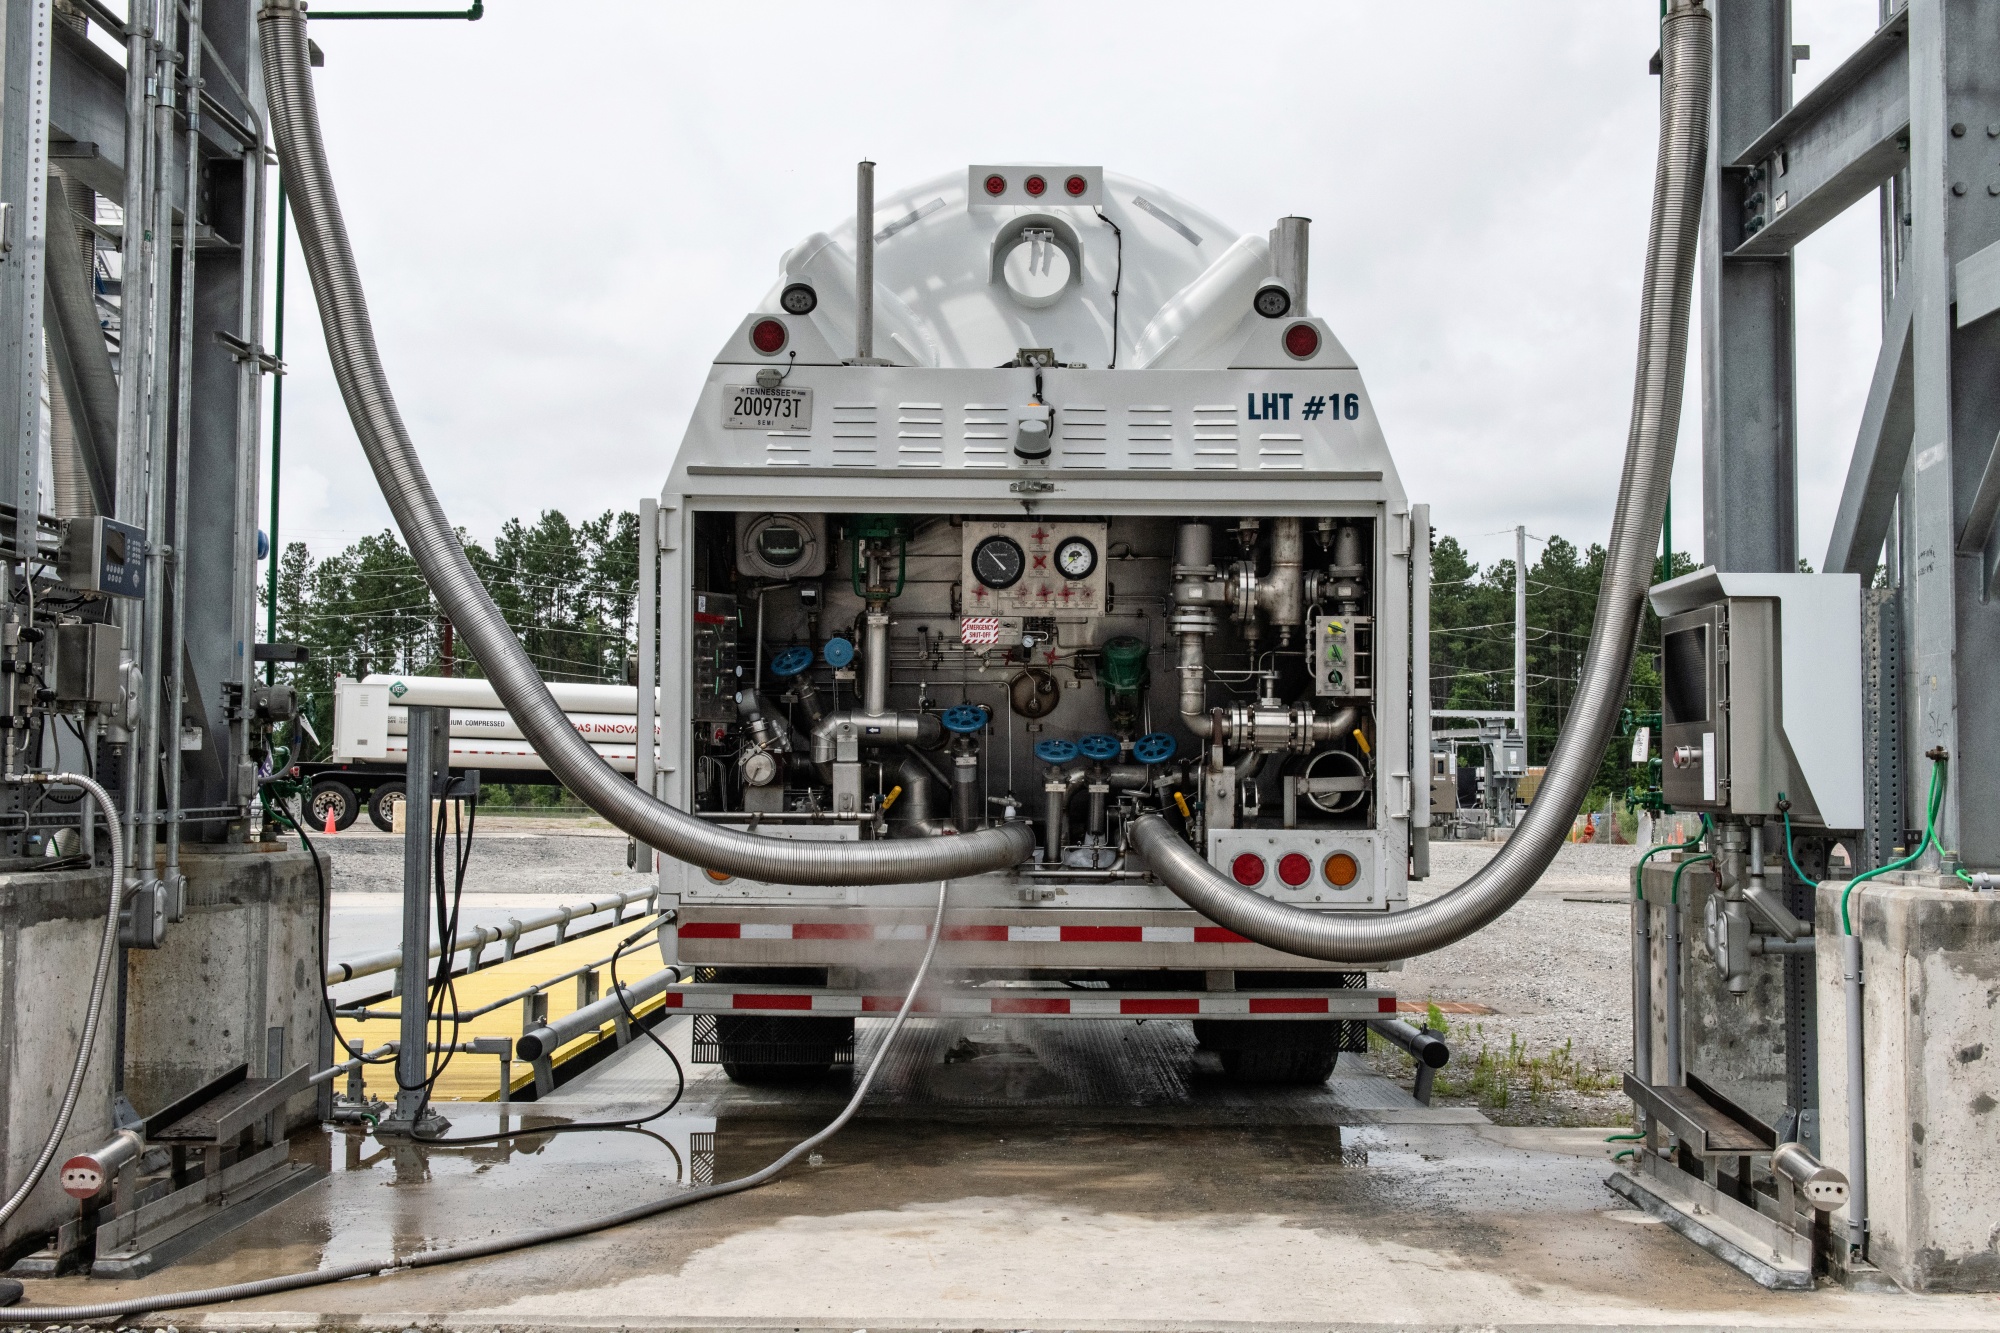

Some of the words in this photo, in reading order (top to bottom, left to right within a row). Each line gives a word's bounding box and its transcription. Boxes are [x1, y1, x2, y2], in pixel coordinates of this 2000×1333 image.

[745, 387, 791, 397] TENNESSEE
[733, 396, 802, 419] 200973T
[1247, 392, 1294, 421] LHT
[1301, 392, 1360, 421] #16
[464, 719, 506, 728] COMPRESSED
